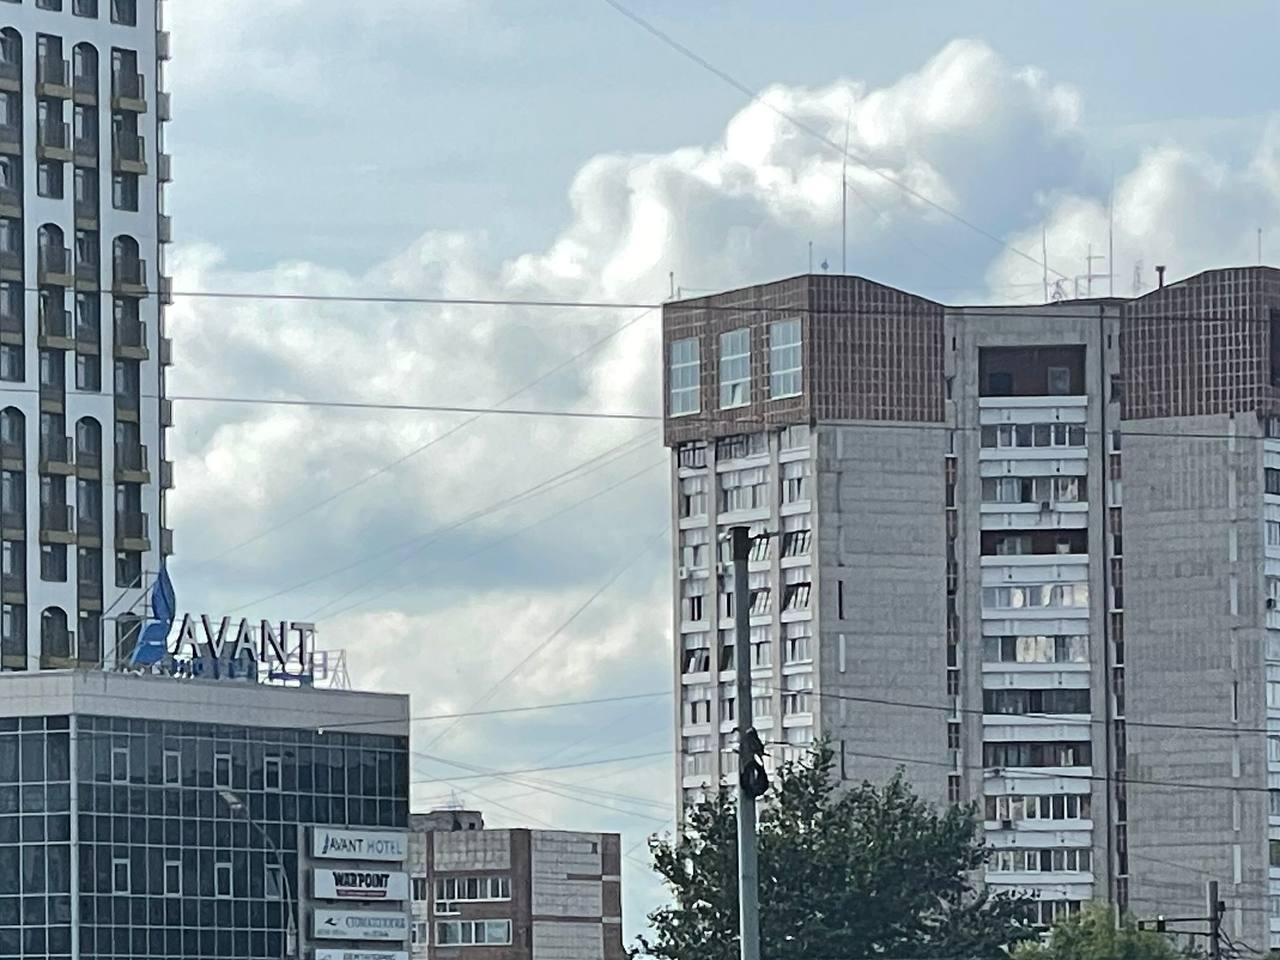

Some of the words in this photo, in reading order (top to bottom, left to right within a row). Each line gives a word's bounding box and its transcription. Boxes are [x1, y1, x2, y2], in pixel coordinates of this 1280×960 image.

[173, 613, 315, 667] AVANT
[329, 837, 365, 853] AVANT
[366, 839, 402, 855] HOTEL
